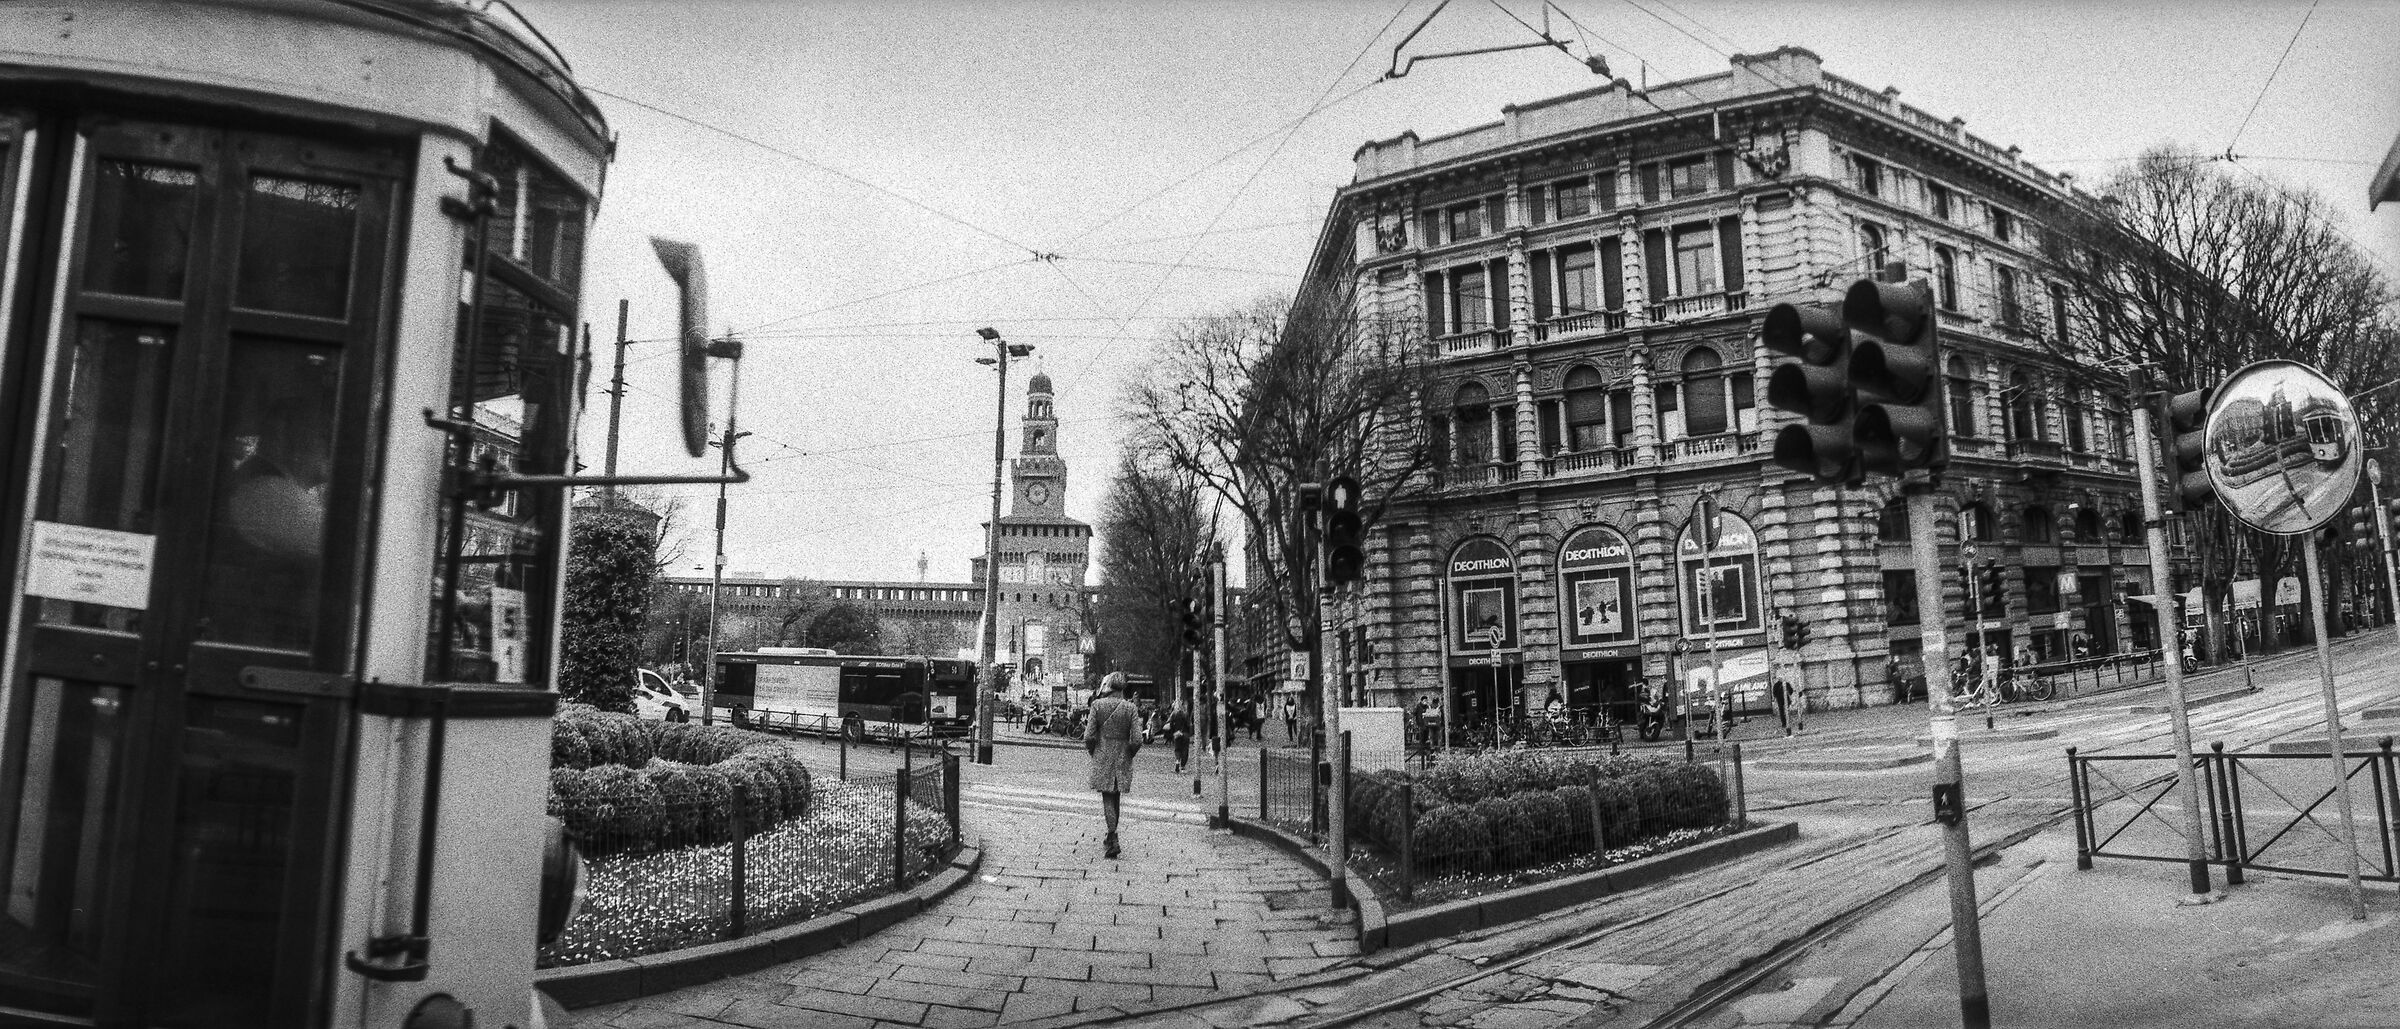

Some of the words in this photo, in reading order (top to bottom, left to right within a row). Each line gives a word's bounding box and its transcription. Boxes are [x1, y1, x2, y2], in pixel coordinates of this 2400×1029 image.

[1565, 545, 1626, 562] DECATHLON
[1454, 557, 1510, 572] DECATHLON
[2060, 575, 2076, 593] M
[1079, 639, 1095, 652] M
[1705, 638, 1743, 648] DCATHLON
[1582, 650, 1619, 659] DECATHLON
[1468, 657, 1491, 666] DECATH
